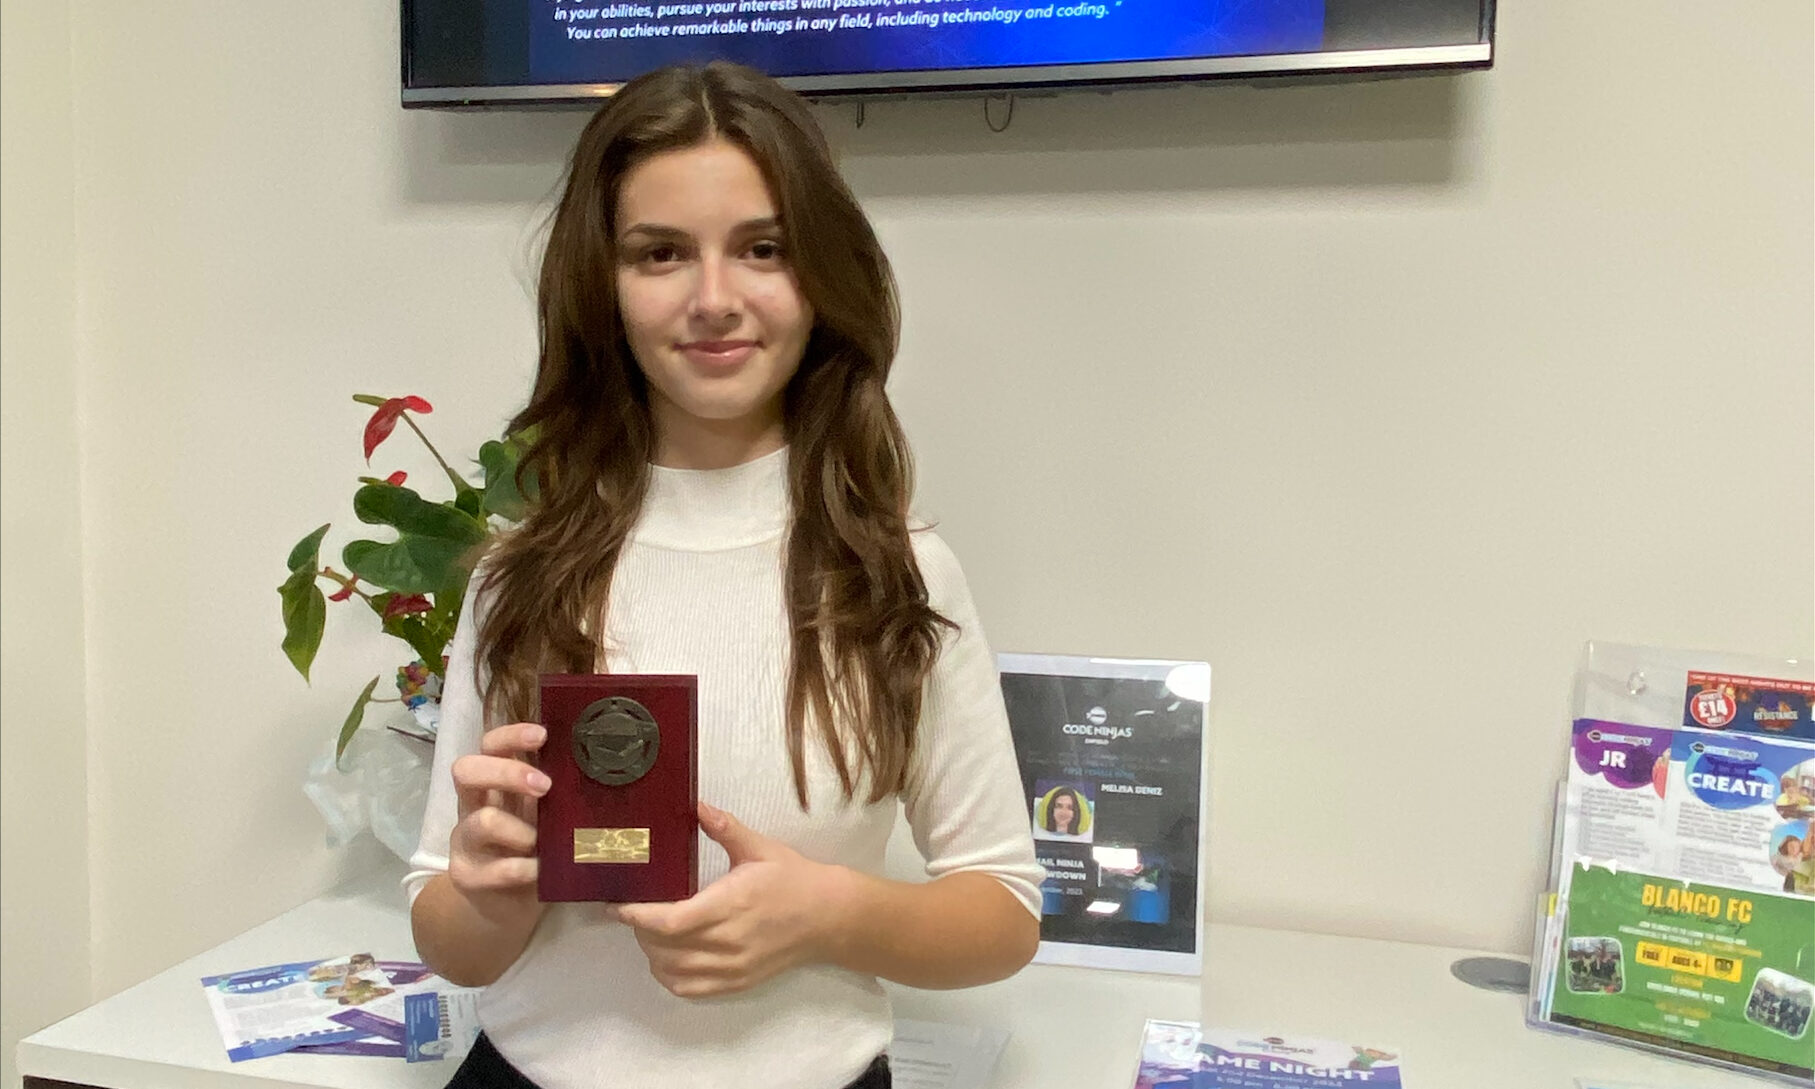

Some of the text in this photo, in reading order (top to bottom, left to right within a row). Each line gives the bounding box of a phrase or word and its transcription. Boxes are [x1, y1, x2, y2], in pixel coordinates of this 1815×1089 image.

[554, 7, 567, 20] in
[569, 8, 600, 22] your
[601, 4, 654, 18] abilities,
[657, 4, 703, 18] pursue
[706, 3, 737, 17] your
[739, 0, 799, 12] interests
[802, 0, 831, 9] with
[833, 0, 891, 11] passion,
[567, 26, 592, 39] You
[594, 27, 618, 38] can
[620, 23, 670, 38] achieve
[672, 19, 748, 36] remarkable
[751, 18, 792, 34] things
[795, 16, 808, 30] in
[810, 18, 839, 32] any
[840, 13, 873, 29] field,
[876, 11, 939, 28] including
[943, 6, 1022, 24] technology
[1025, 4, 1054, 19] and
[1056, 2, 1109, 19] coding.
[1698, 699, 1728, 718] £14
[1062, 724, 1133, 739] CODE NINJAS
[1599, 749, 1627, 769] JR
[1687, 773, 1775, 800] CREATE
[1046, 870, 1087, 880] WDOWN
[1641, 884, 1721, 918] BLANCO
[1726, 898, 1753, 924] FC
[1198, 1054, 1375, 1081] AME NIGHT
